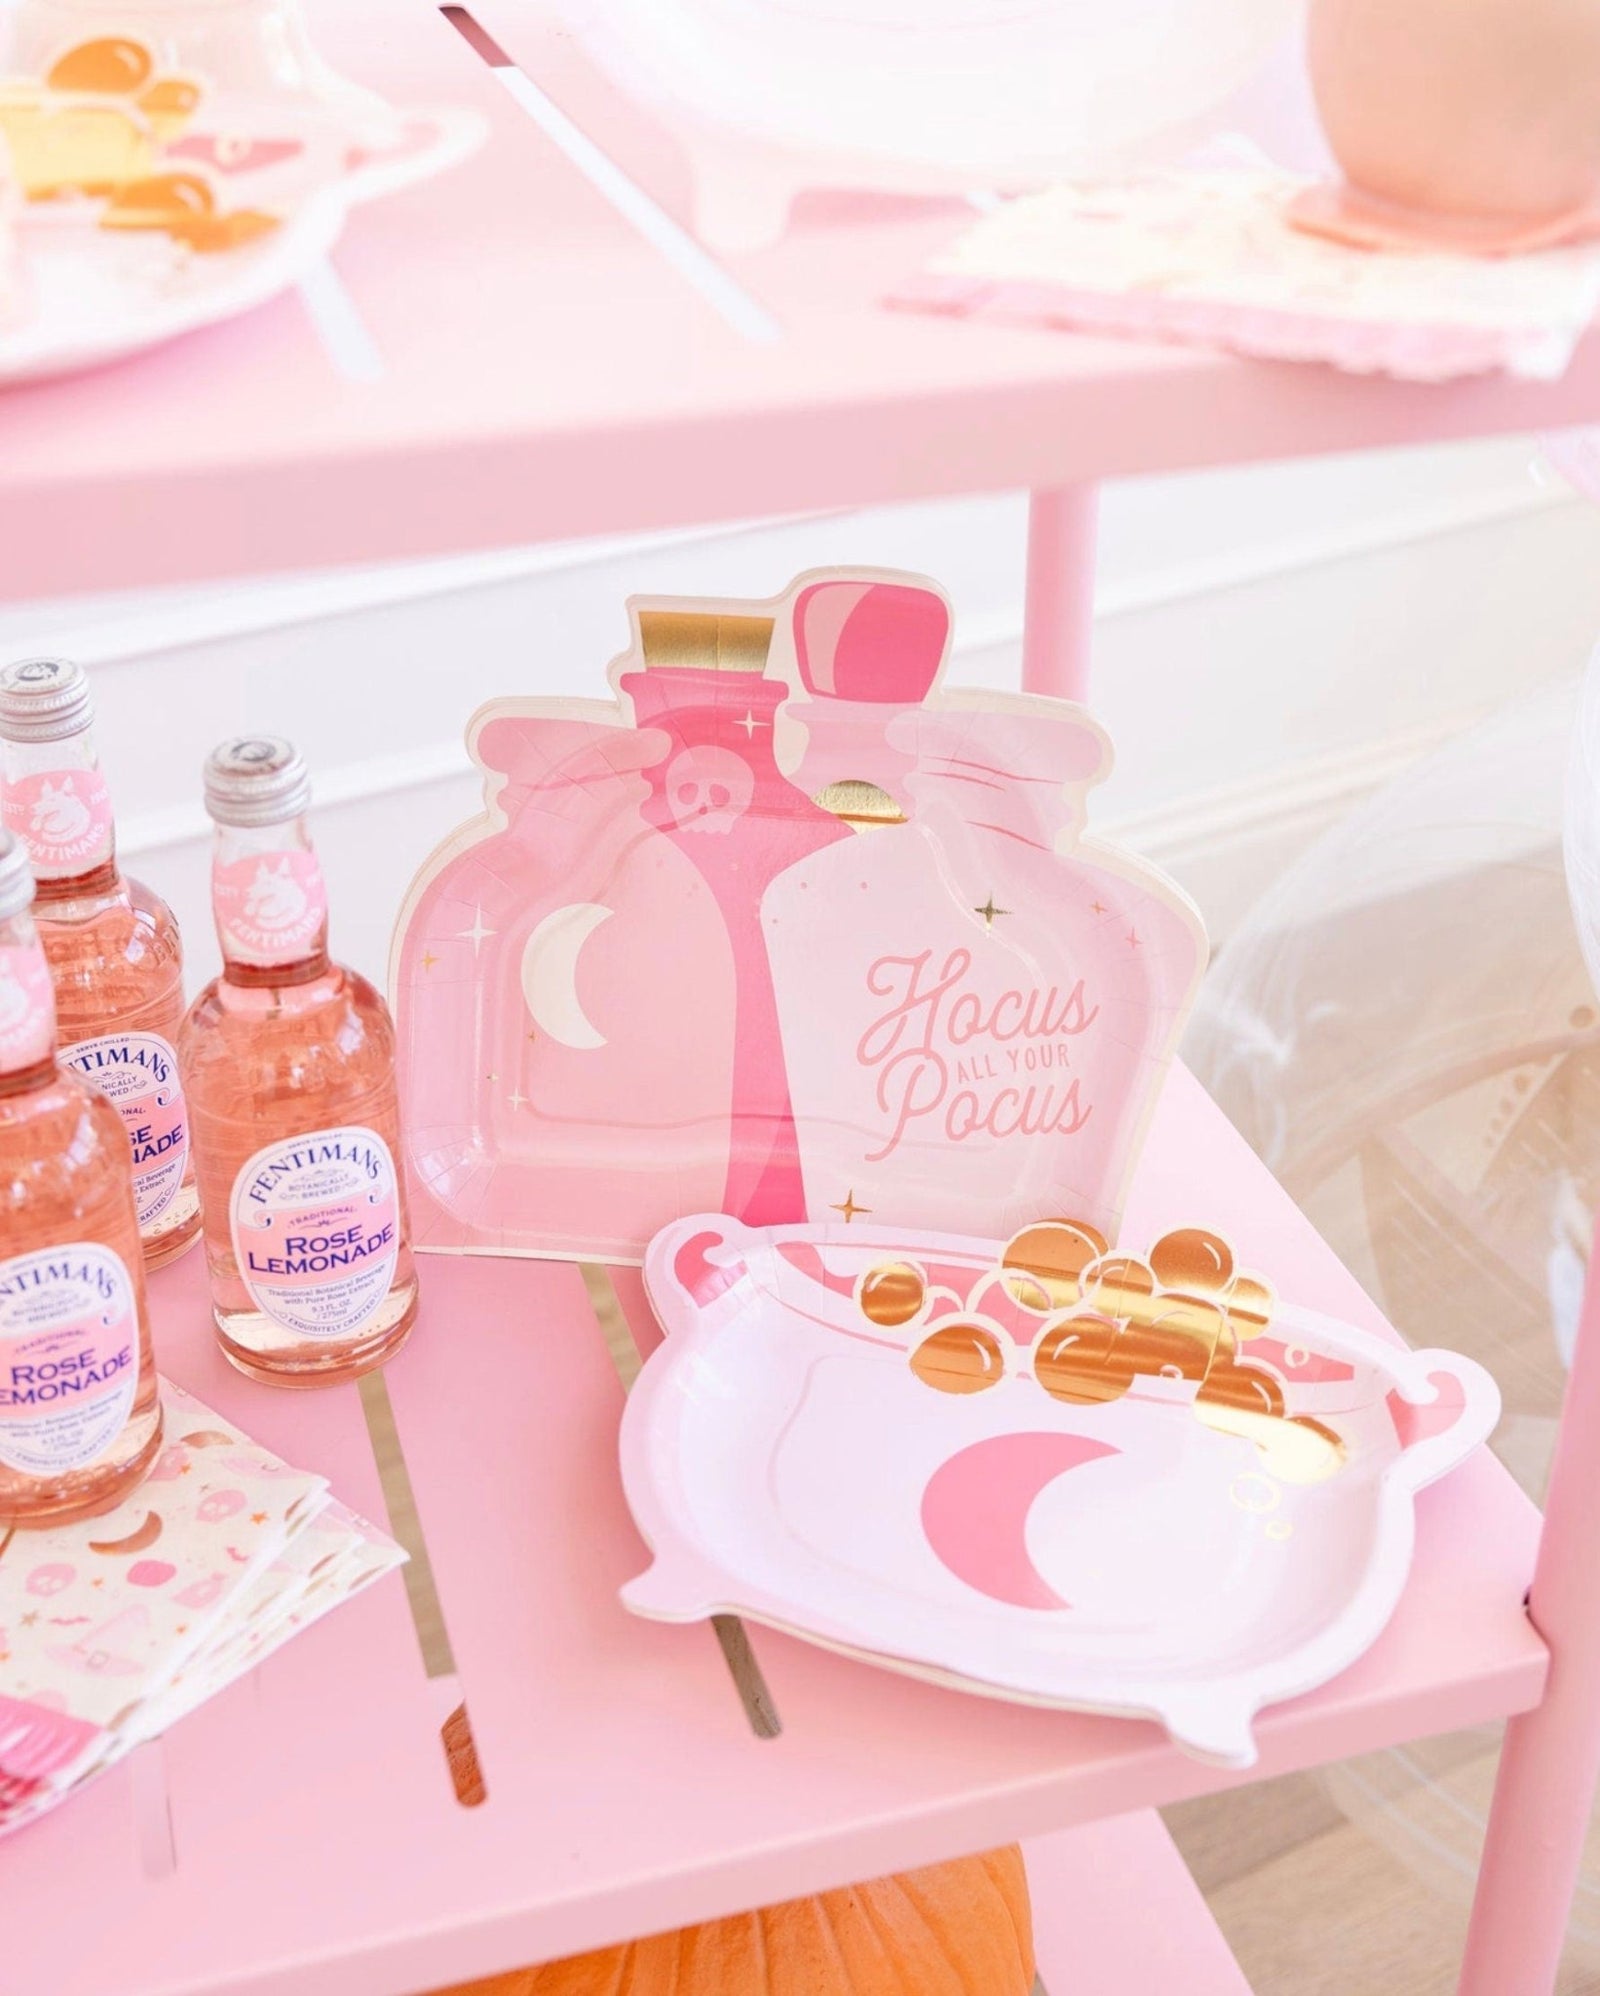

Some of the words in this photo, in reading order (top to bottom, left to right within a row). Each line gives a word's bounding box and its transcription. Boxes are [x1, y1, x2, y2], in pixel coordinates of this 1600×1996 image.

[856, 948, 1100, 1066] Hocus
[68, 1047, 170, 1082] TIMANS
[957, 1054, 998, 1084] ALL
[1006, 1043, 1070, 1073] YOUR
[102, 1075, 137, 1090] NICALLY
[109, 1088, 129, 1098] WED
[864, 1047, 1093, 1162] Pocus
[249, 1143, 382, 1204] FENTIMANS
[288, 1173, 350, 1192] BOTANICALLY
[140, 1197, 167, 1222] RAFTED
[301, 1186, 341, 1199] BREWED
[290, 1206, 355, 1226] TRADITIONAL
[248, 1223, 394, 1275] LEMONADE
[286, 1224, 363, 1256] ROSE
[0, 1262, 116, 1304] NTIMANS
[268, 1287, 314, 1297] Traditional
[315, 1281, 354, 1296] Botanical
[355, 1263, 387, 1285] Beverage
[284, 1296, 303, 1305] with
[305, 1294, 325, 1305] Pure
[327, 1290, 347, 1301] Rose
[348, 1279, 376, 1295] Extract
[288, 1317, 341, 1333] EXQUISITELY
[343, 1299, 376, 1328] CRAFTED
[0, 1345, 132, 1405] EMONADE
[11, 1347, 98, 1386] ROSE
